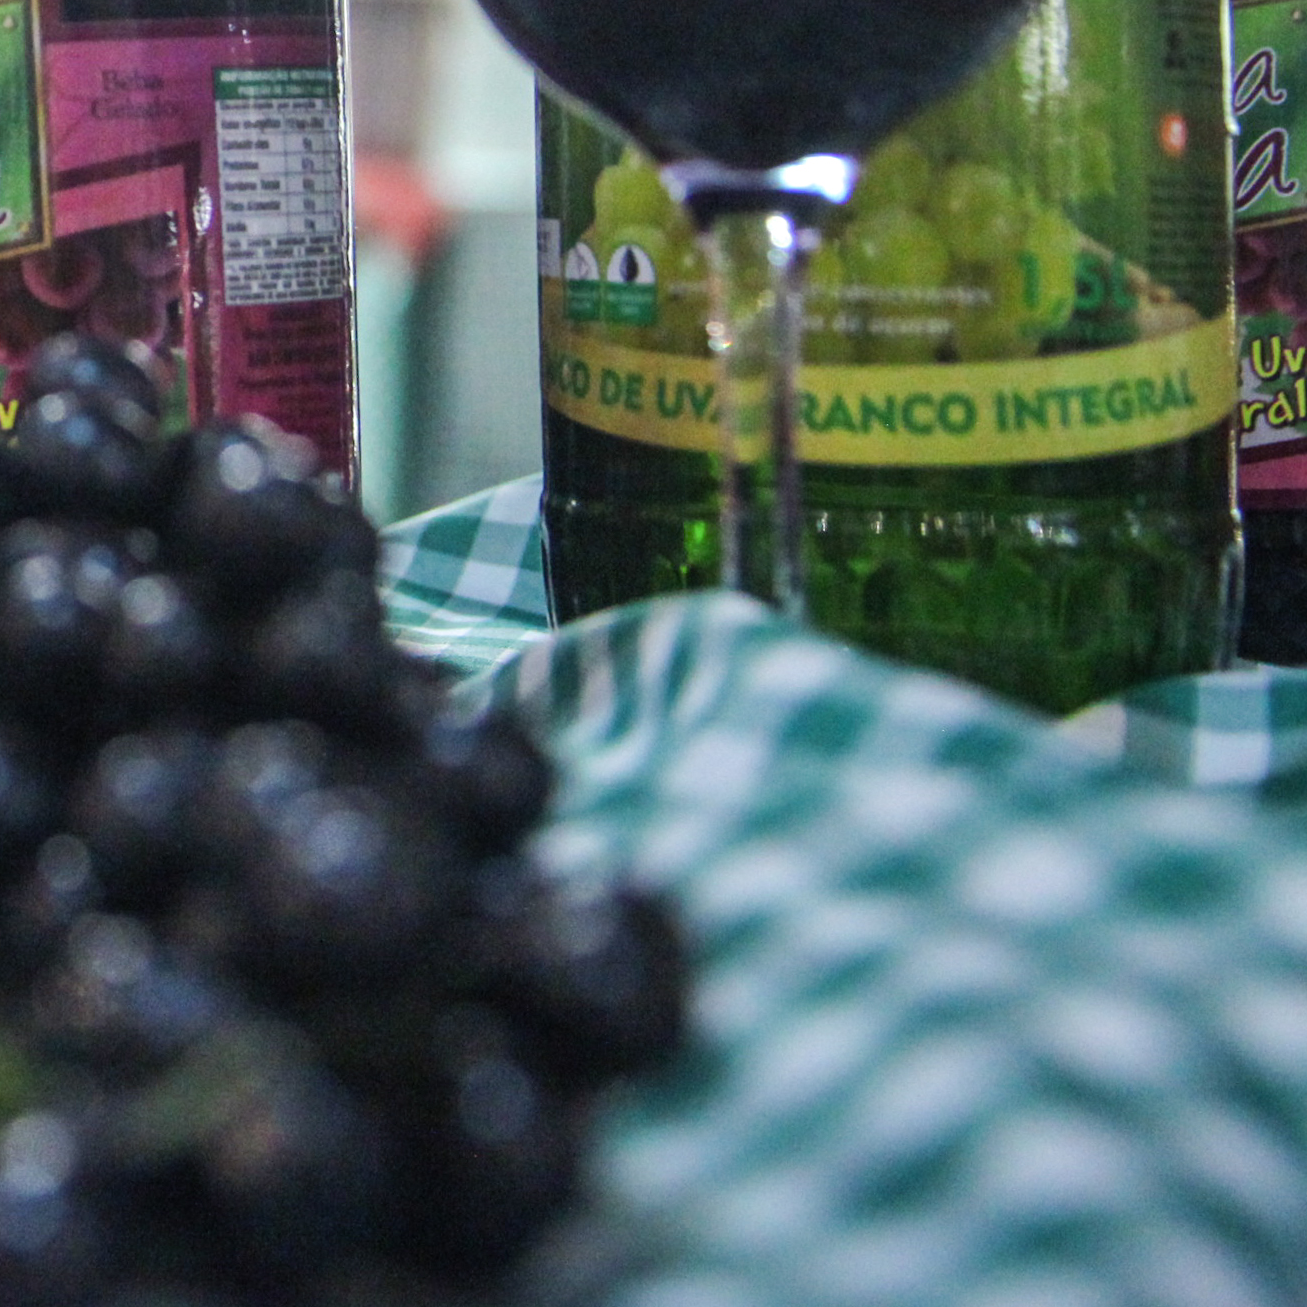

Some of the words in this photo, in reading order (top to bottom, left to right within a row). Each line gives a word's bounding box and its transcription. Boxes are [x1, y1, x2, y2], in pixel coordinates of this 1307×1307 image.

[1251, 336, 1306, 379] Uv
[600, 368, 644, 413] DE
[656, 376, 723, 424] UV
[799, 389, 978, 435] RANCO
[995, 368, 1197, 434] INTEGRAL
